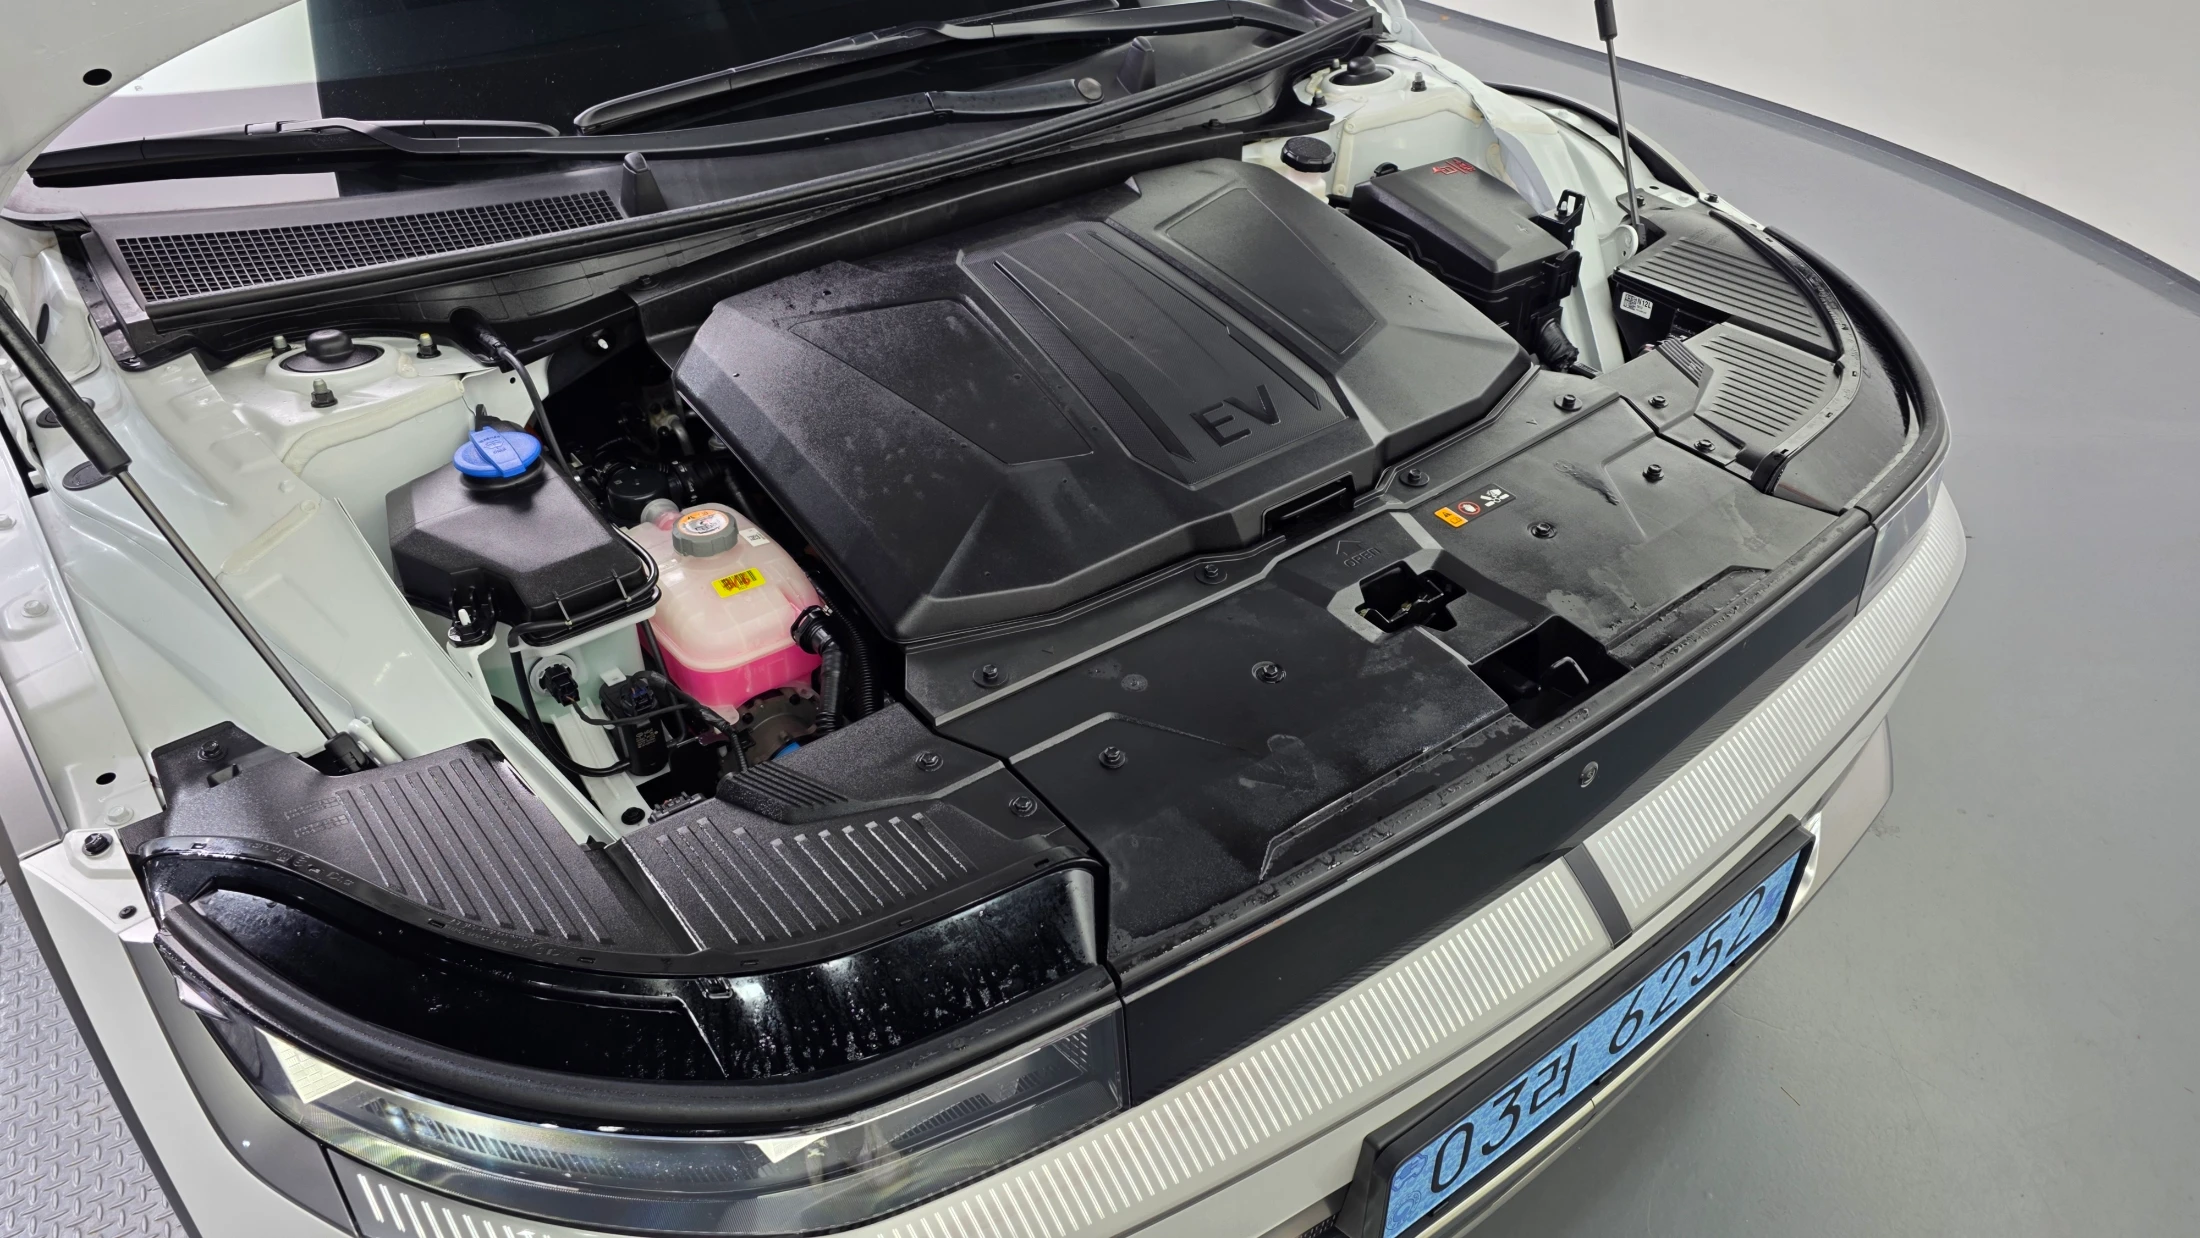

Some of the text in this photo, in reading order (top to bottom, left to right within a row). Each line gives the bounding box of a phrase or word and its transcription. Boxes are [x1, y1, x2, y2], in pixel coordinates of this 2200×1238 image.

[1190, 384, 1280, 447] EV
[1343, 547, 1381, 567] OPEN
[1430, 885, 1766, 1193] 03러 6252
